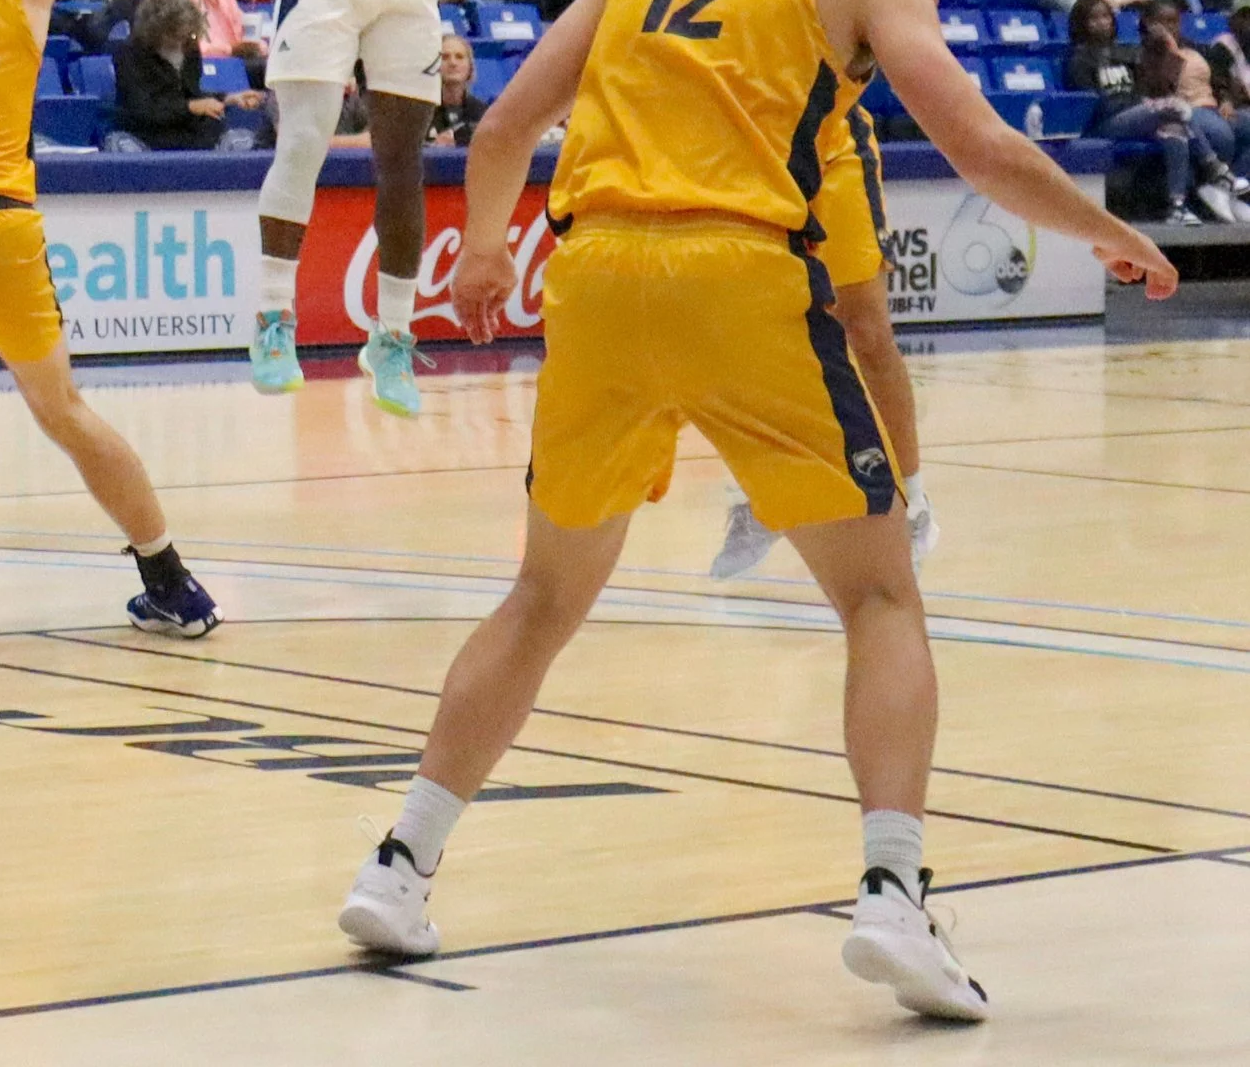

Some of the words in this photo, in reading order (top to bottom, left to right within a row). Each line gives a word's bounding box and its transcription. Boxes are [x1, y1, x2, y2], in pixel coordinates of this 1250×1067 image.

[47, 209, 236, 304] ealth
[940, 192, 1015, 296] 6
[887, 252, 937, 292] nel
[997, 262, 1027, 279] abc
[94, 313, 236, 339] UNIVERSITY
